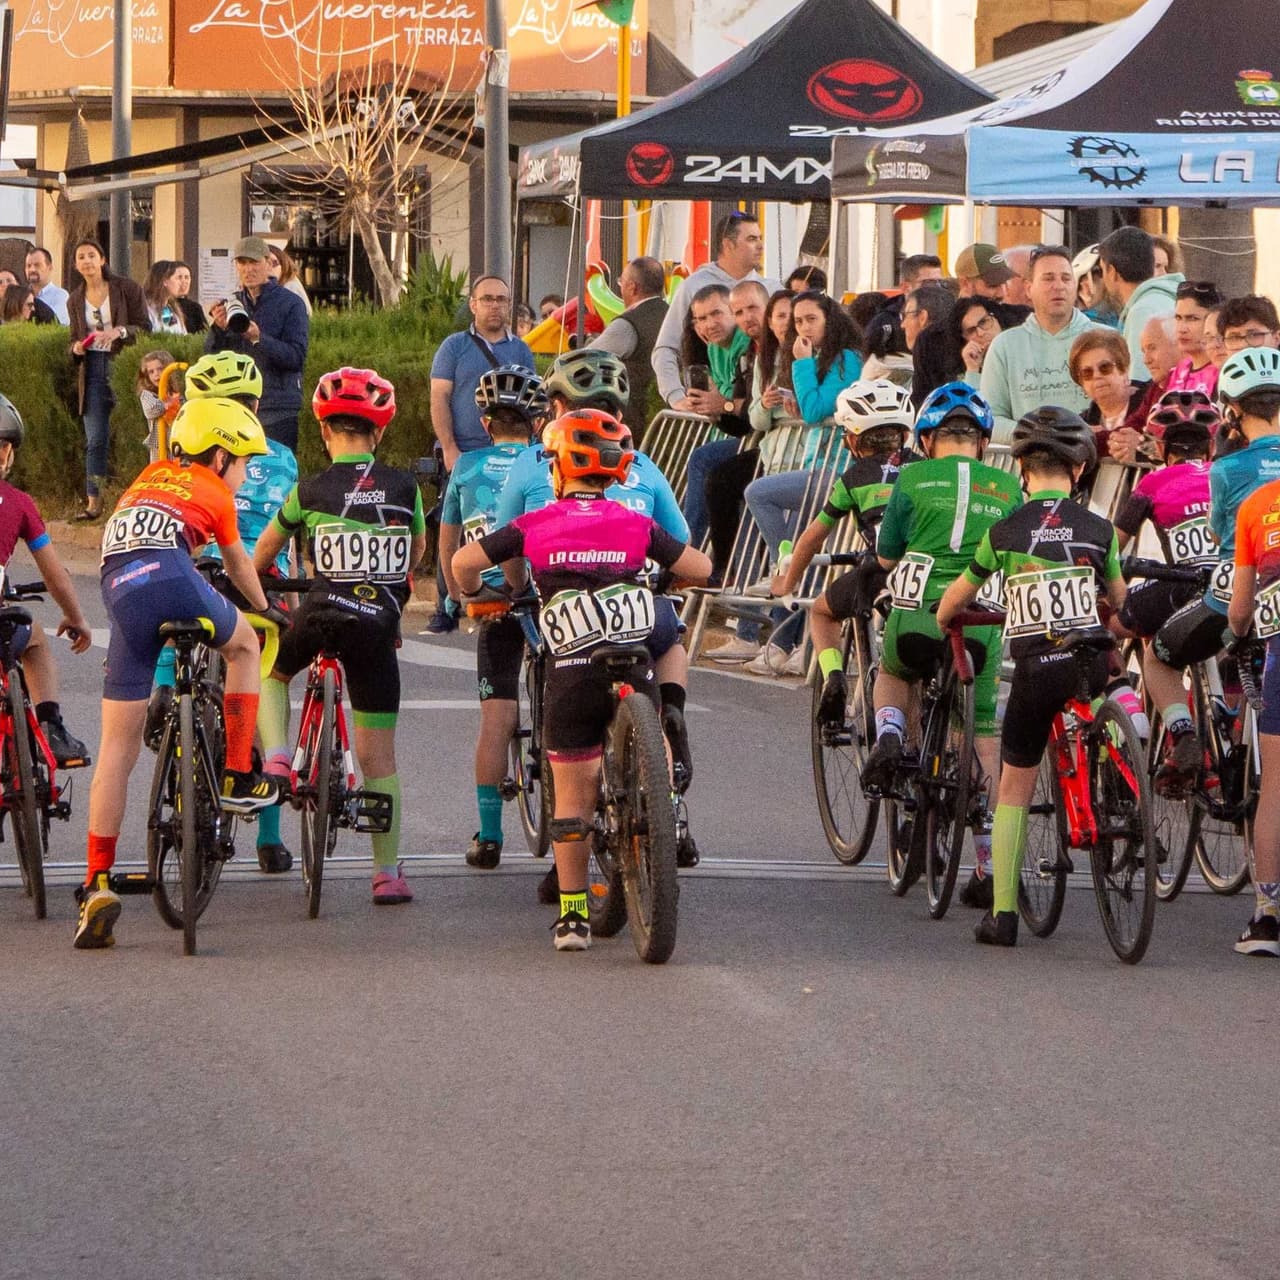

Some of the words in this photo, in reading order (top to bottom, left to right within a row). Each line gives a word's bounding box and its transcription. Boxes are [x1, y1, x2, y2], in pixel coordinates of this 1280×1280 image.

[403, 26, 484, 46] TERRAZA
[1156, 117, 1248, 128] RIBERA
[1178, 149, 1257, 185] LA
[131, 509, 178, 538] 806
[320, 533, 364, 570] 819
[368, 535, 407, 573] 819
[548, 551, 566, 566] LA
[568, 549, 627, 564] CAÑADA
[327, 592, 335, 602] LA
[335, 595, 360, 611] PISCINA
[360, 604, 377, 616] TEAM
[605, 590, 650, 632] 811
[1009, 583, 1043, 627] 816
[1048, 576, 1093, 620] 816
[543, 596, 594, 645] 811
[1039, 655, 1049, 664] LA
